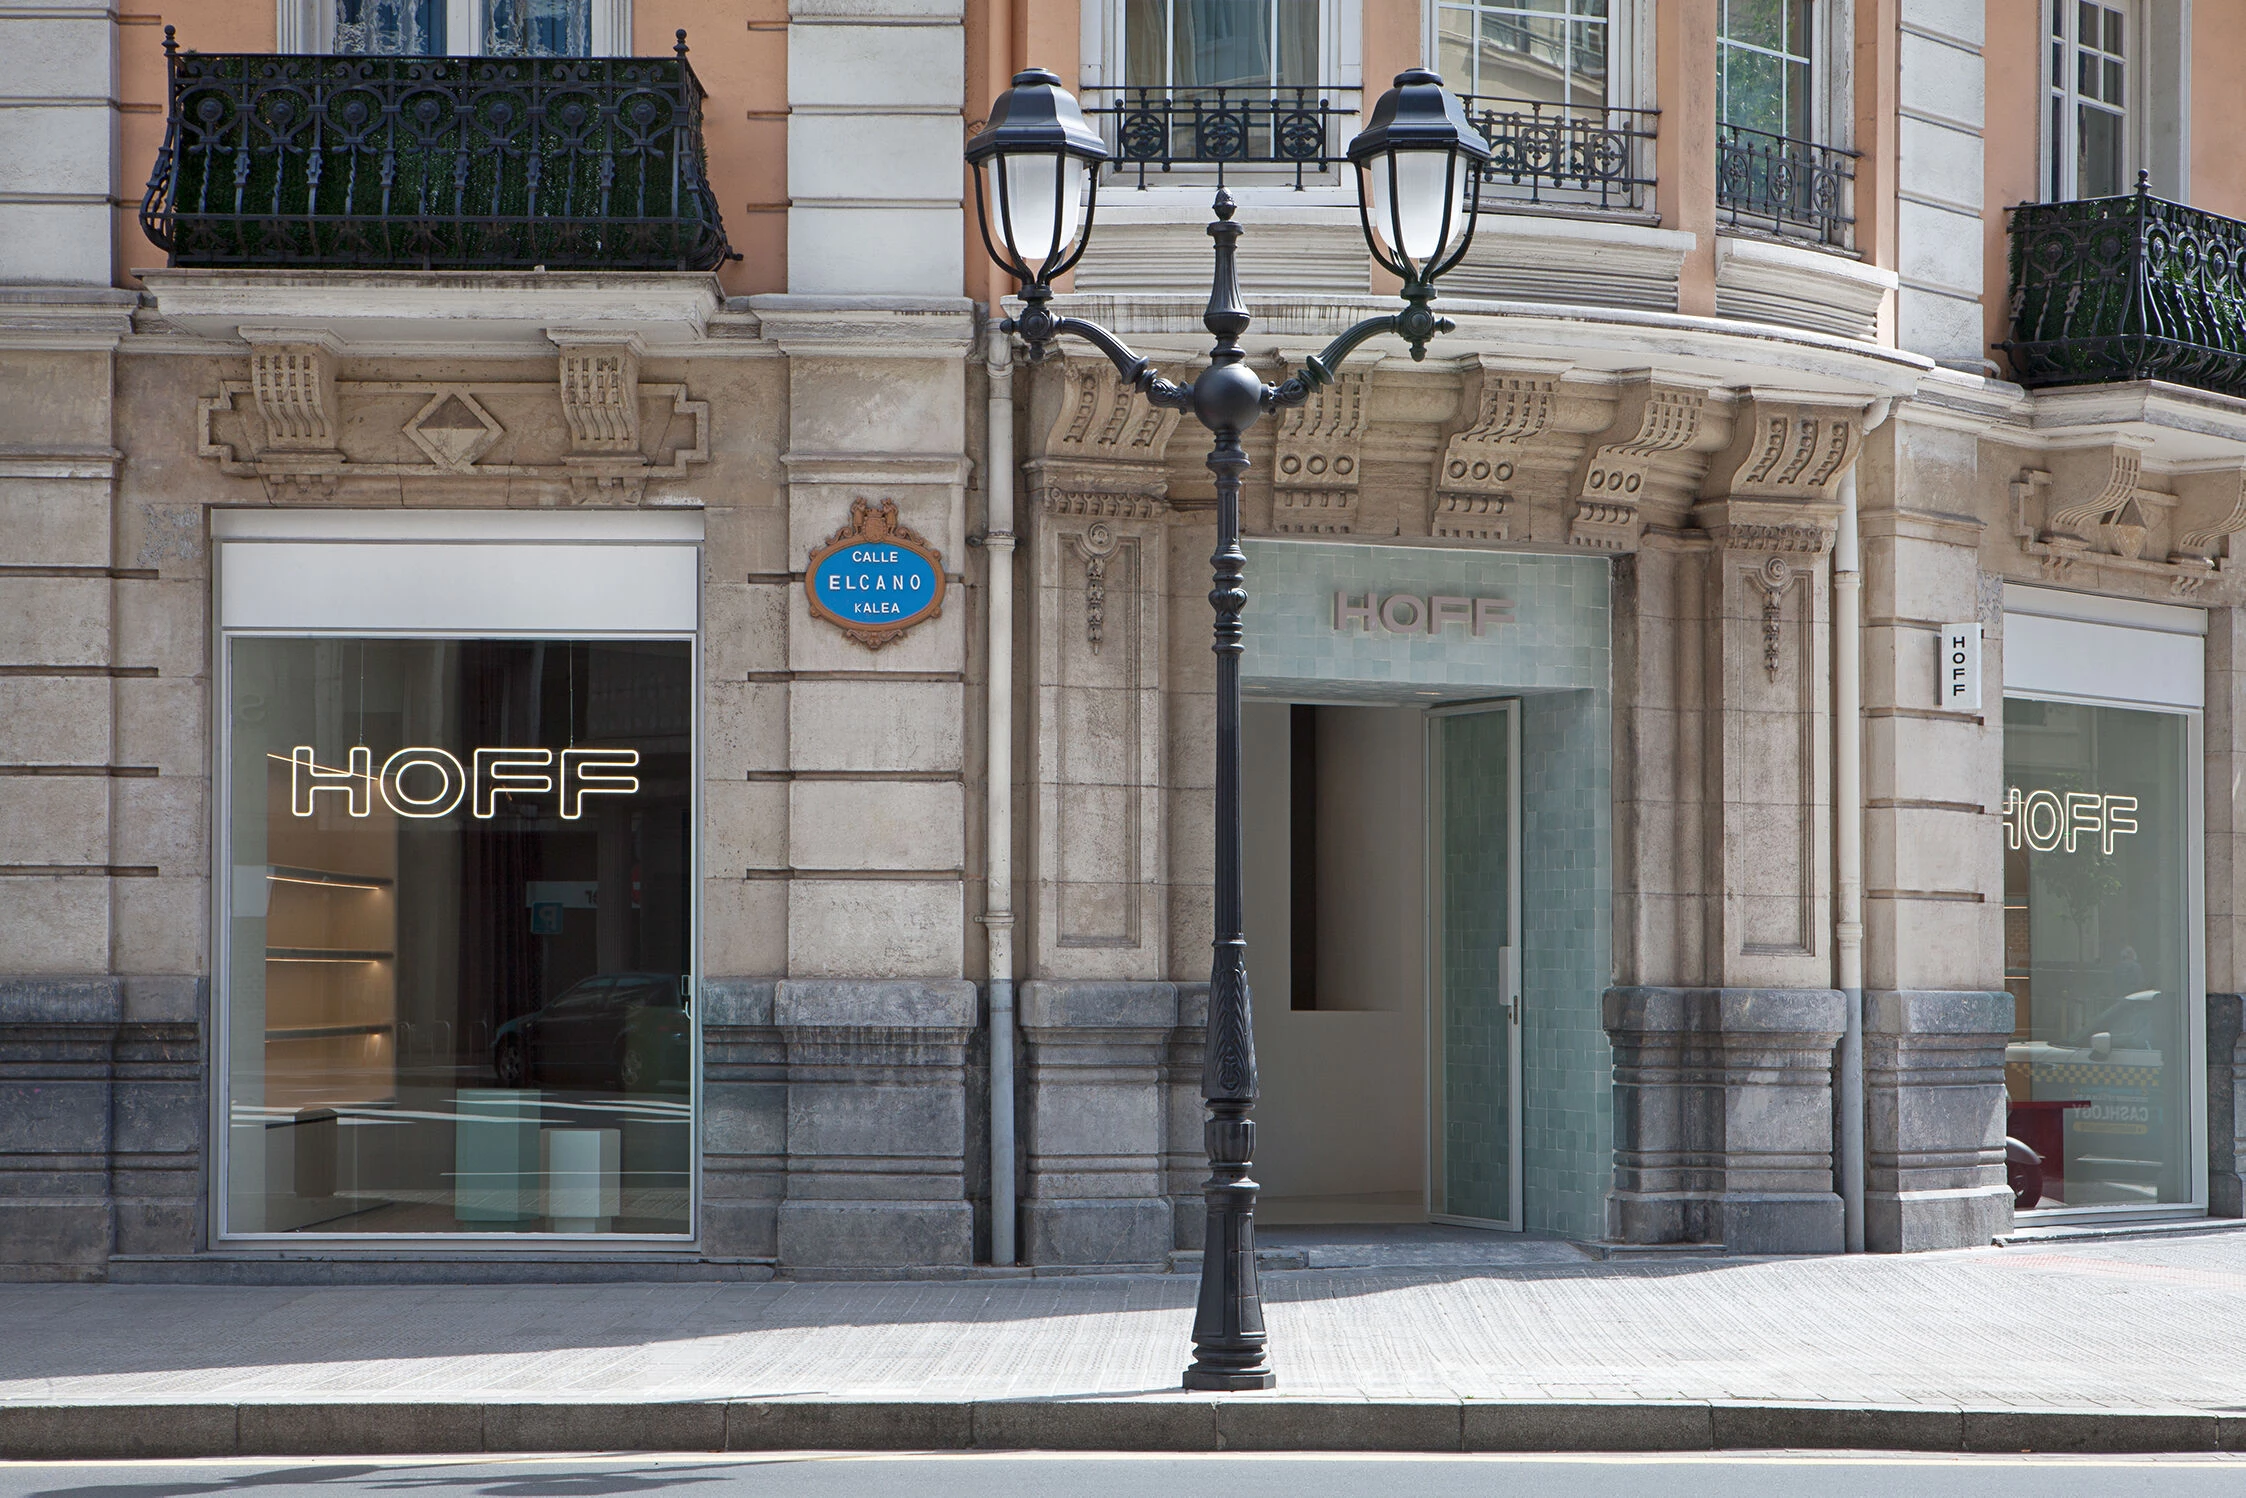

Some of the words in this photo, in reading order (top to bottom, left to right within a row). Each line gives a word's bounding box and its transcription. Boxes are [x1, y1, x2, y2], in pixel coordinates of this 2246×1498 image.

[852, 551, 898, 563] CALLE
[828, 574, 921, 591] ELCANO
[854, 602, 900, 614] KALEA
[1333, 591, 1516, 637] HOFF
[1952, 636, 1966, 697] HOFF
[292, 745, 640, 821] HOFF
